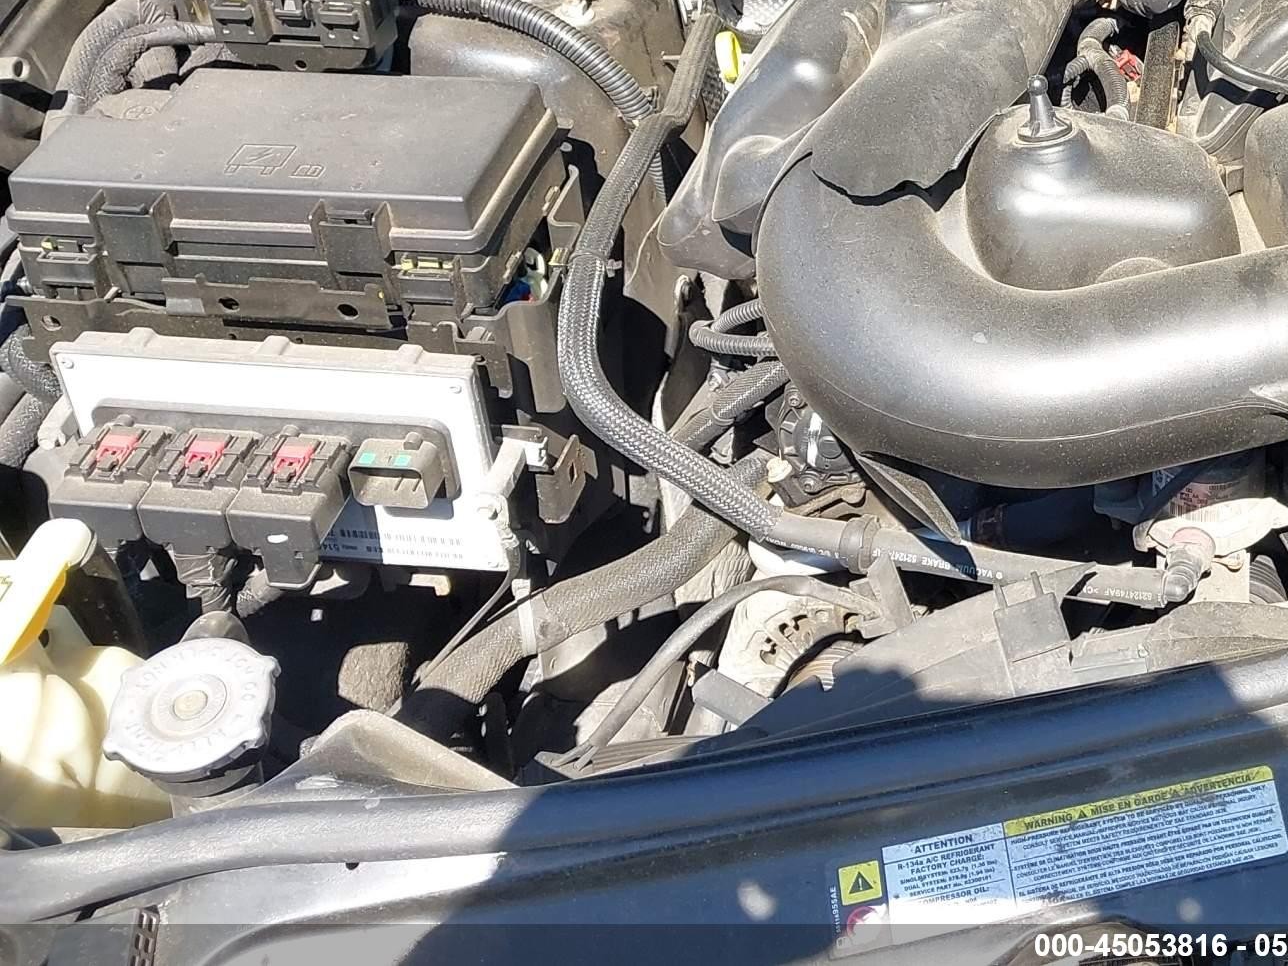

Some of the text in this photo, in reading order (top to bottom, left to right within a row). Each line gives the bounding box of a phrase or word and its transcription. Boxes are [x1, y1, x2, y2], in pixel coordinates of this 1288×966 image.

[922, 555, 951, 570] BRAKE
[958, 562, 994, 580] VACUUM
[1024, 773, 1250, 829] WARNING MISE EN GARDE ADVERTENCIA
[913, 834, 973, 854] ATTENTION
[897, 843, 995, 870] R-134a A/C REFRIGERANT
[910, 853, 984, 874] FACTORY CHARGE:
[973, 885, 989, 894] OIL:
